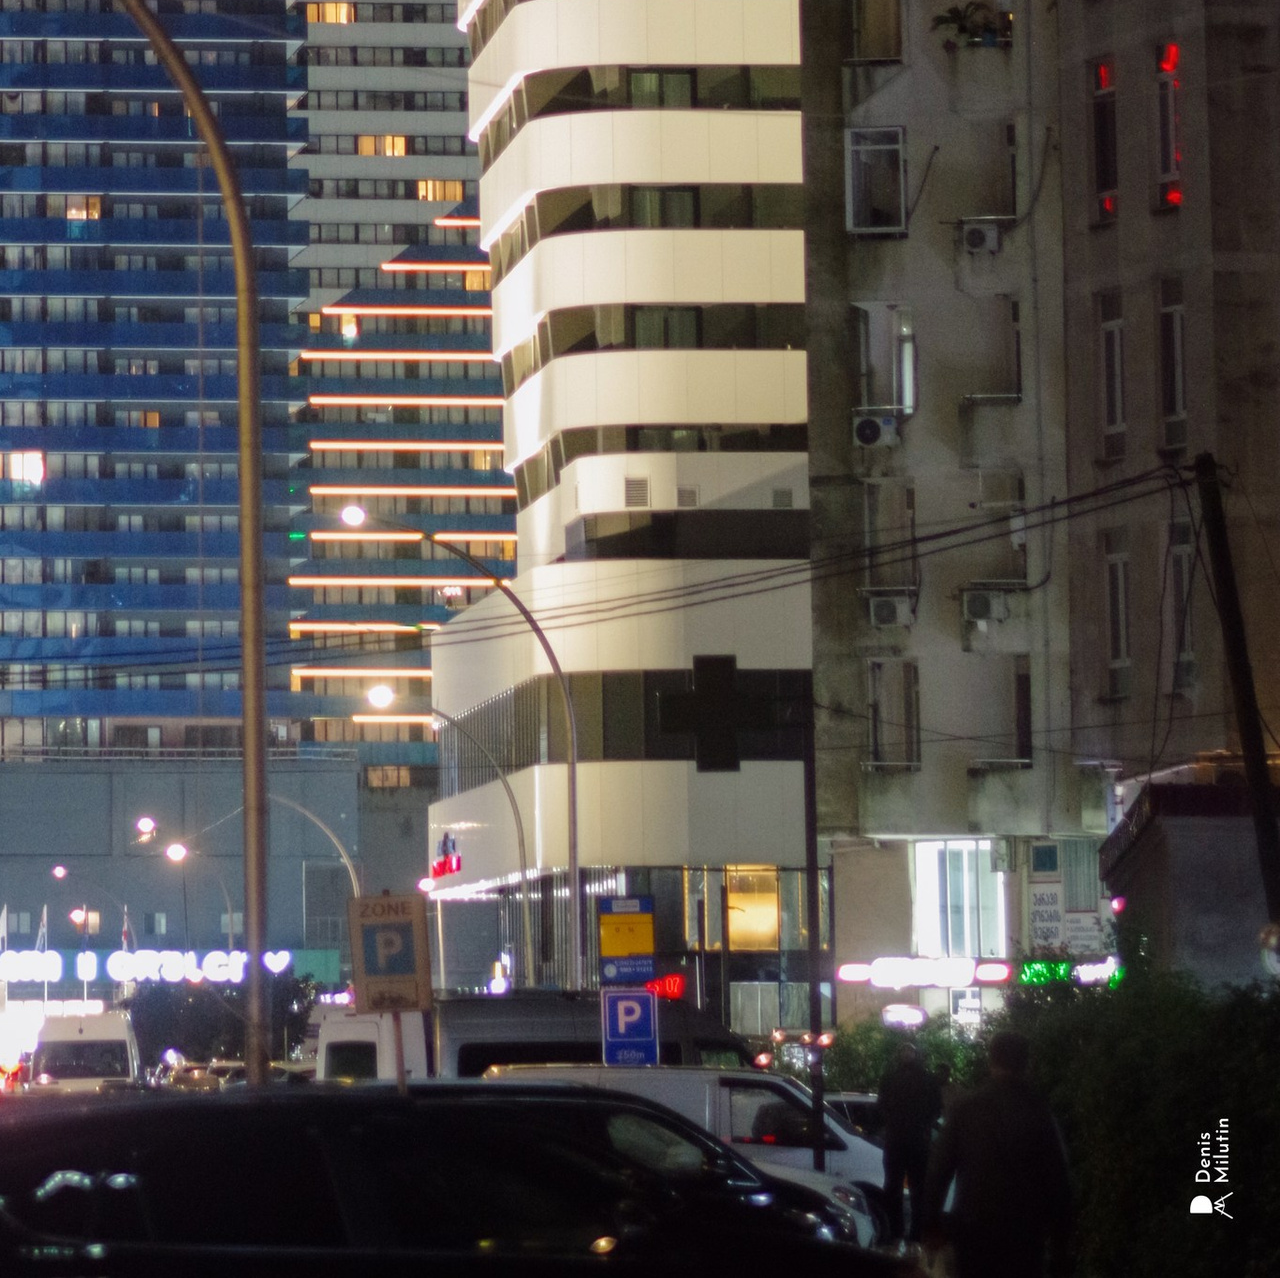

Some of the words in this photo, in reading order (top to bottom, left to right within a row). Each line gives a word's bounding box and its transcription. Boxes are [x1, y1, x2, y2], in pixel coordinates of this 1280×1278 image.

[360, 902, 412, 918] ZONE
[376, 930, 403, 970] P
[617, 1000, 642, 1034] P
